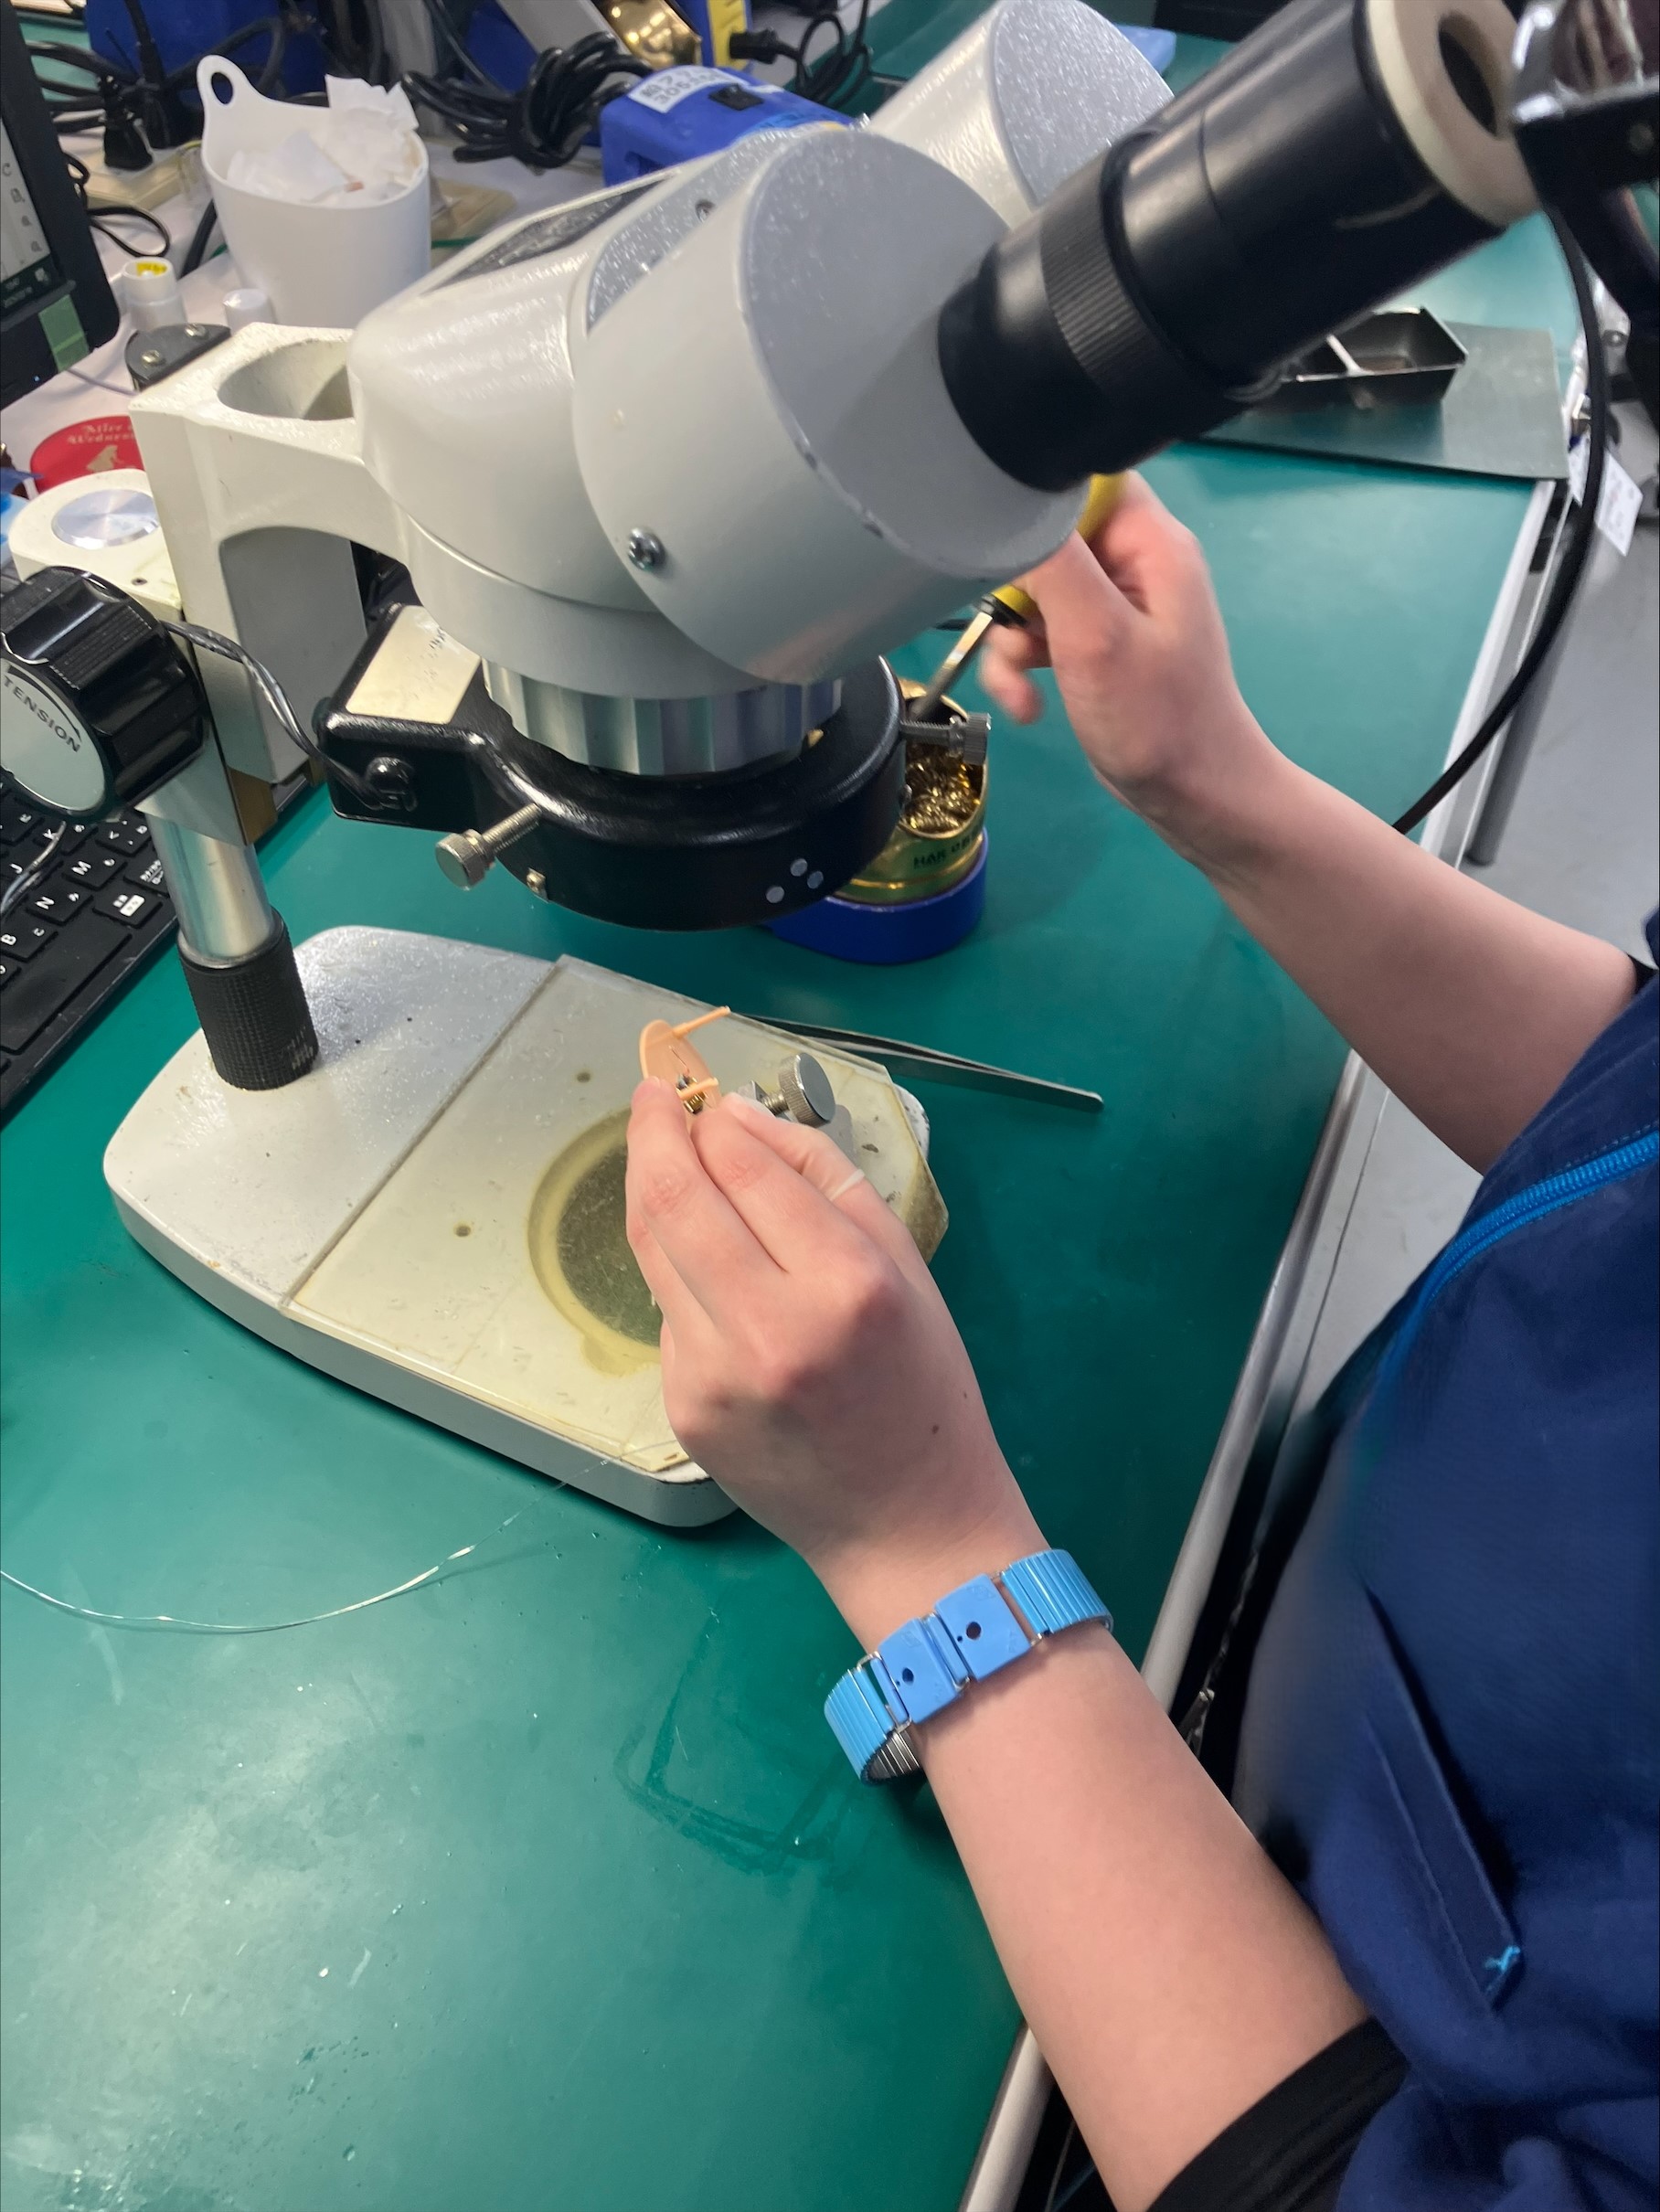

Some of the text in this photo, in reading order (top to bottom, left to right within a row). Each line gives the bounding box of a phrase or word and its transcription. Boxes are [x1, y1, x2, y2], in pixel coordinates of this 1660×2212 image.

[5, 675, 80, 752] TENSION
[43, 829, 59, 841] K
[10, 863, 23, 874] J
[71, 861, 91, 876] M
[36, 896, 55, 910] N
[1, 934, 17, 946] B
